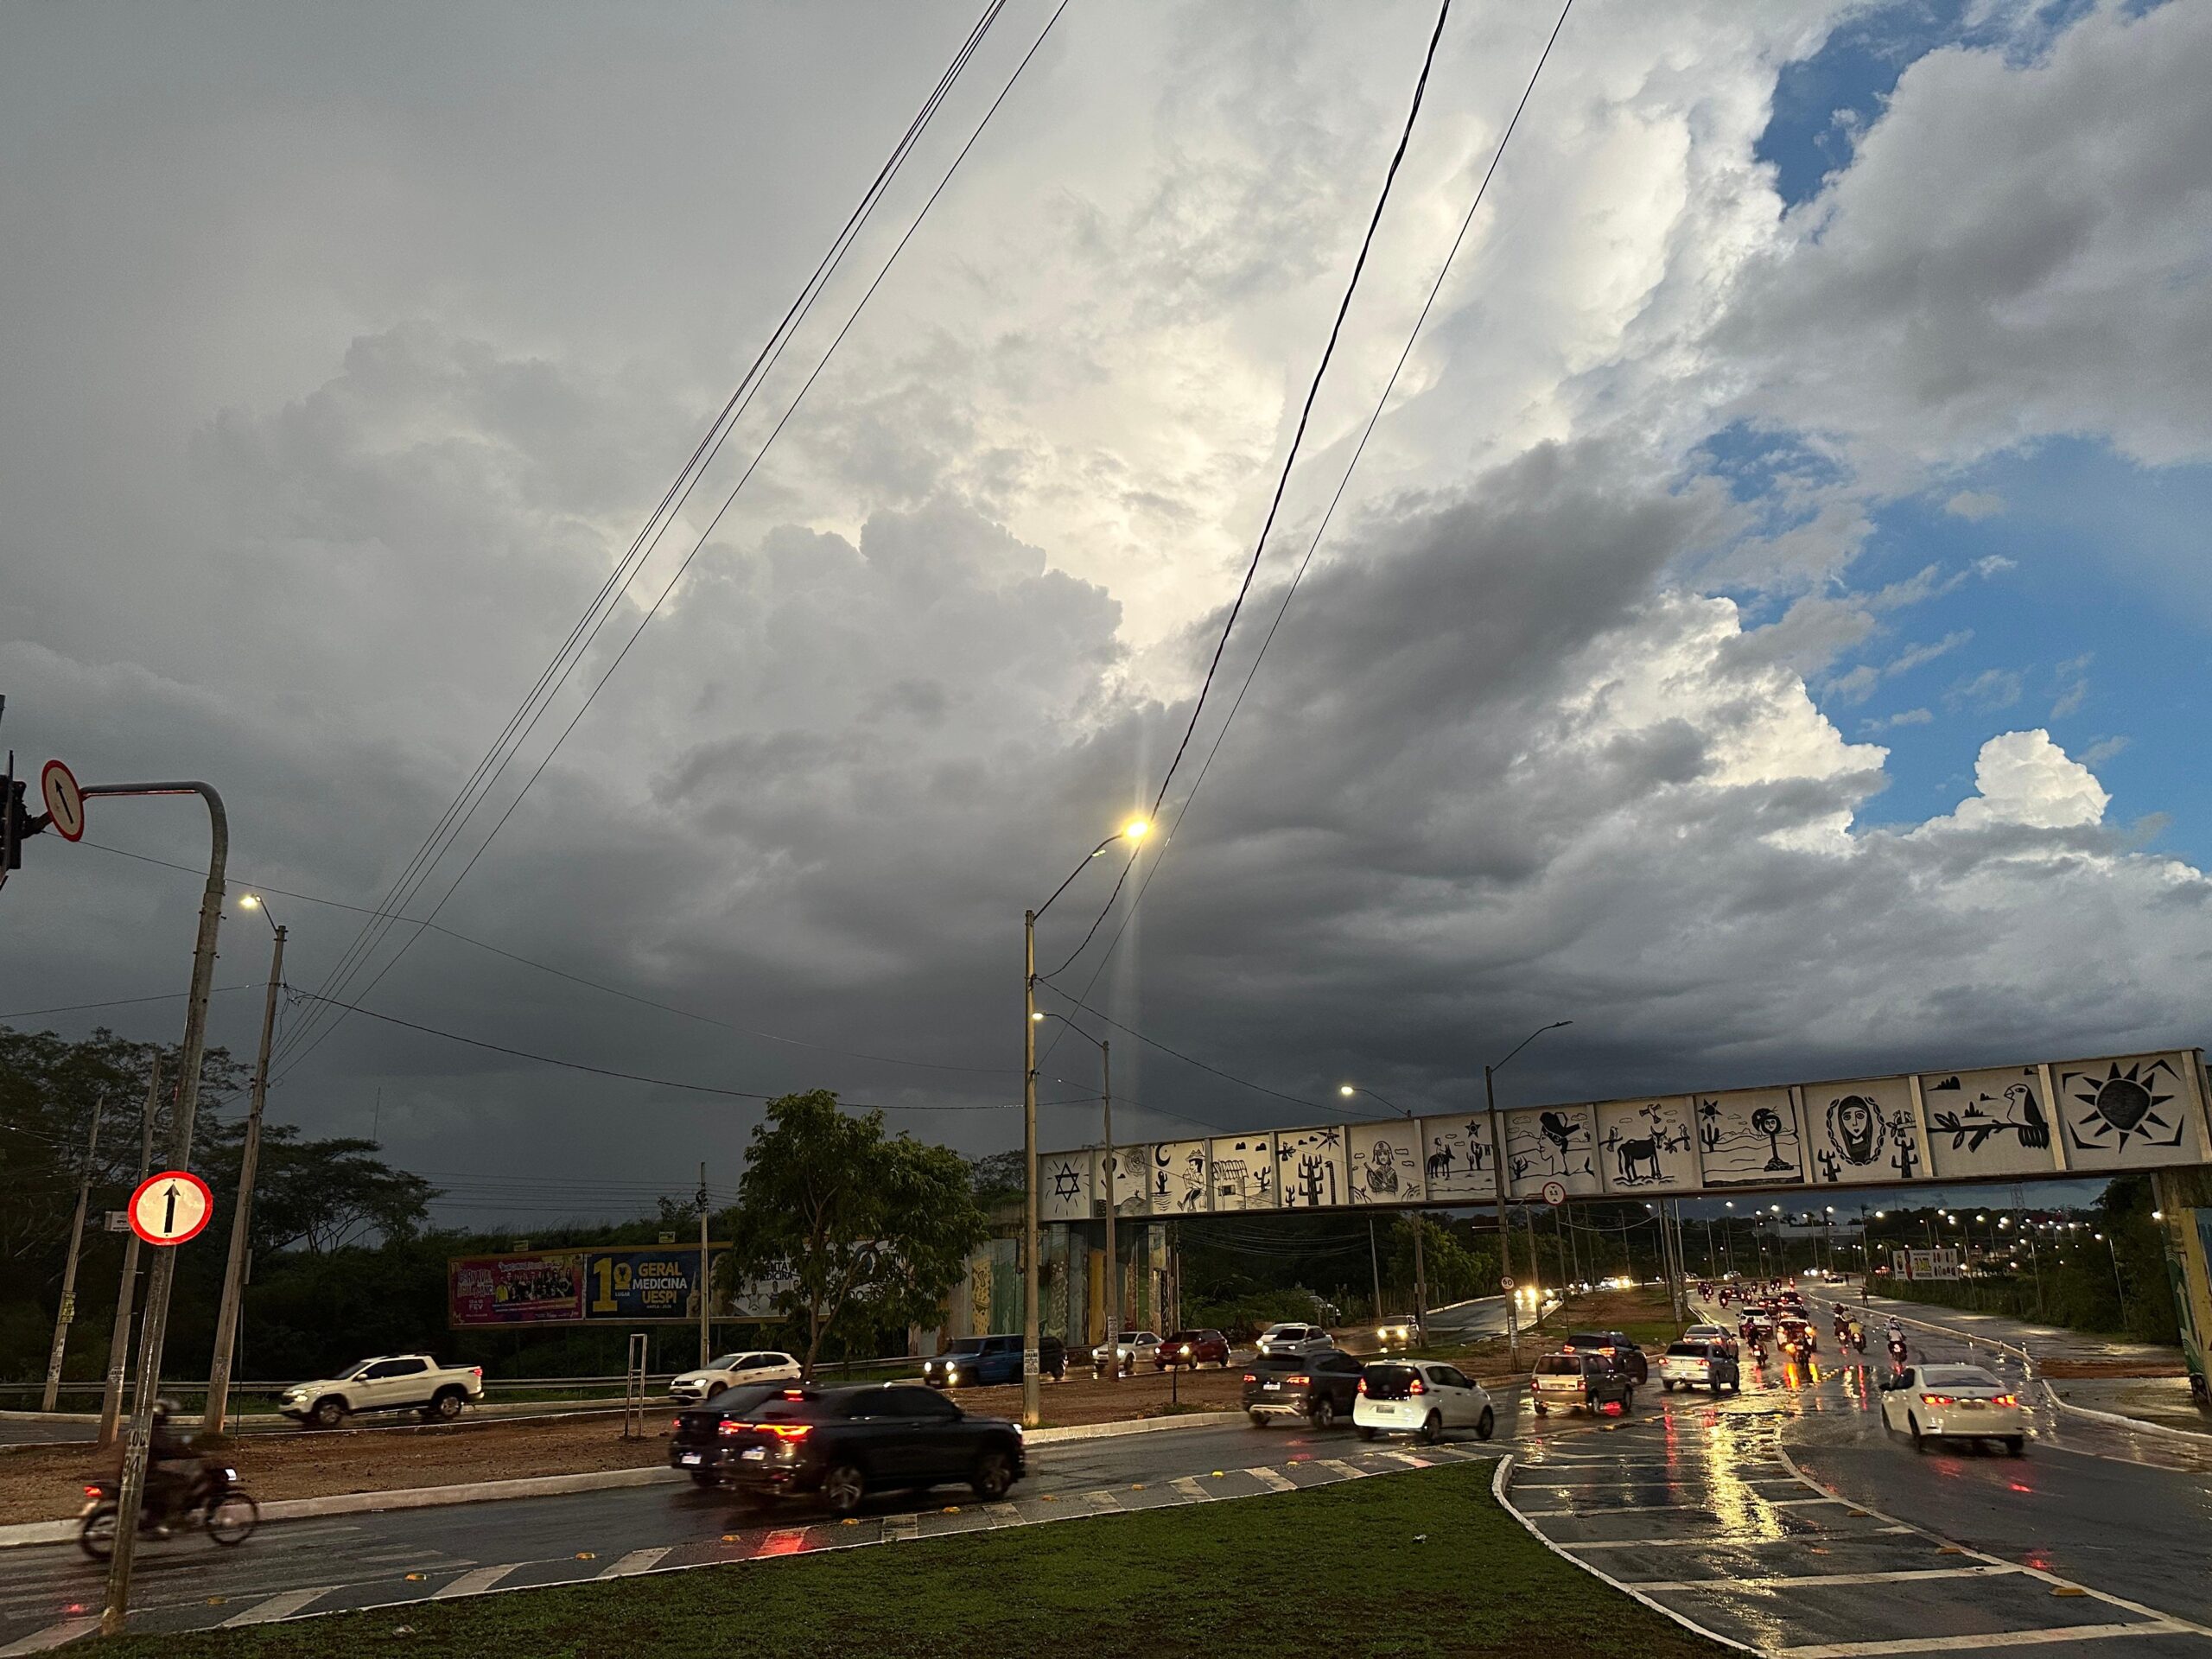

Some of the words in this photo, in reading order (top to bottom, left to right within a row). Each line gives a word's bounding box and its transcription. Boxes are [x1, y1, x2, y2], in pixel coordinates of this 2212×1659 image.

[638, 1262, 683, 1277] GERAL
[632, 1277, 688, 1290] MEDICINA
[642, 1290, 677, 1304] UESPI
